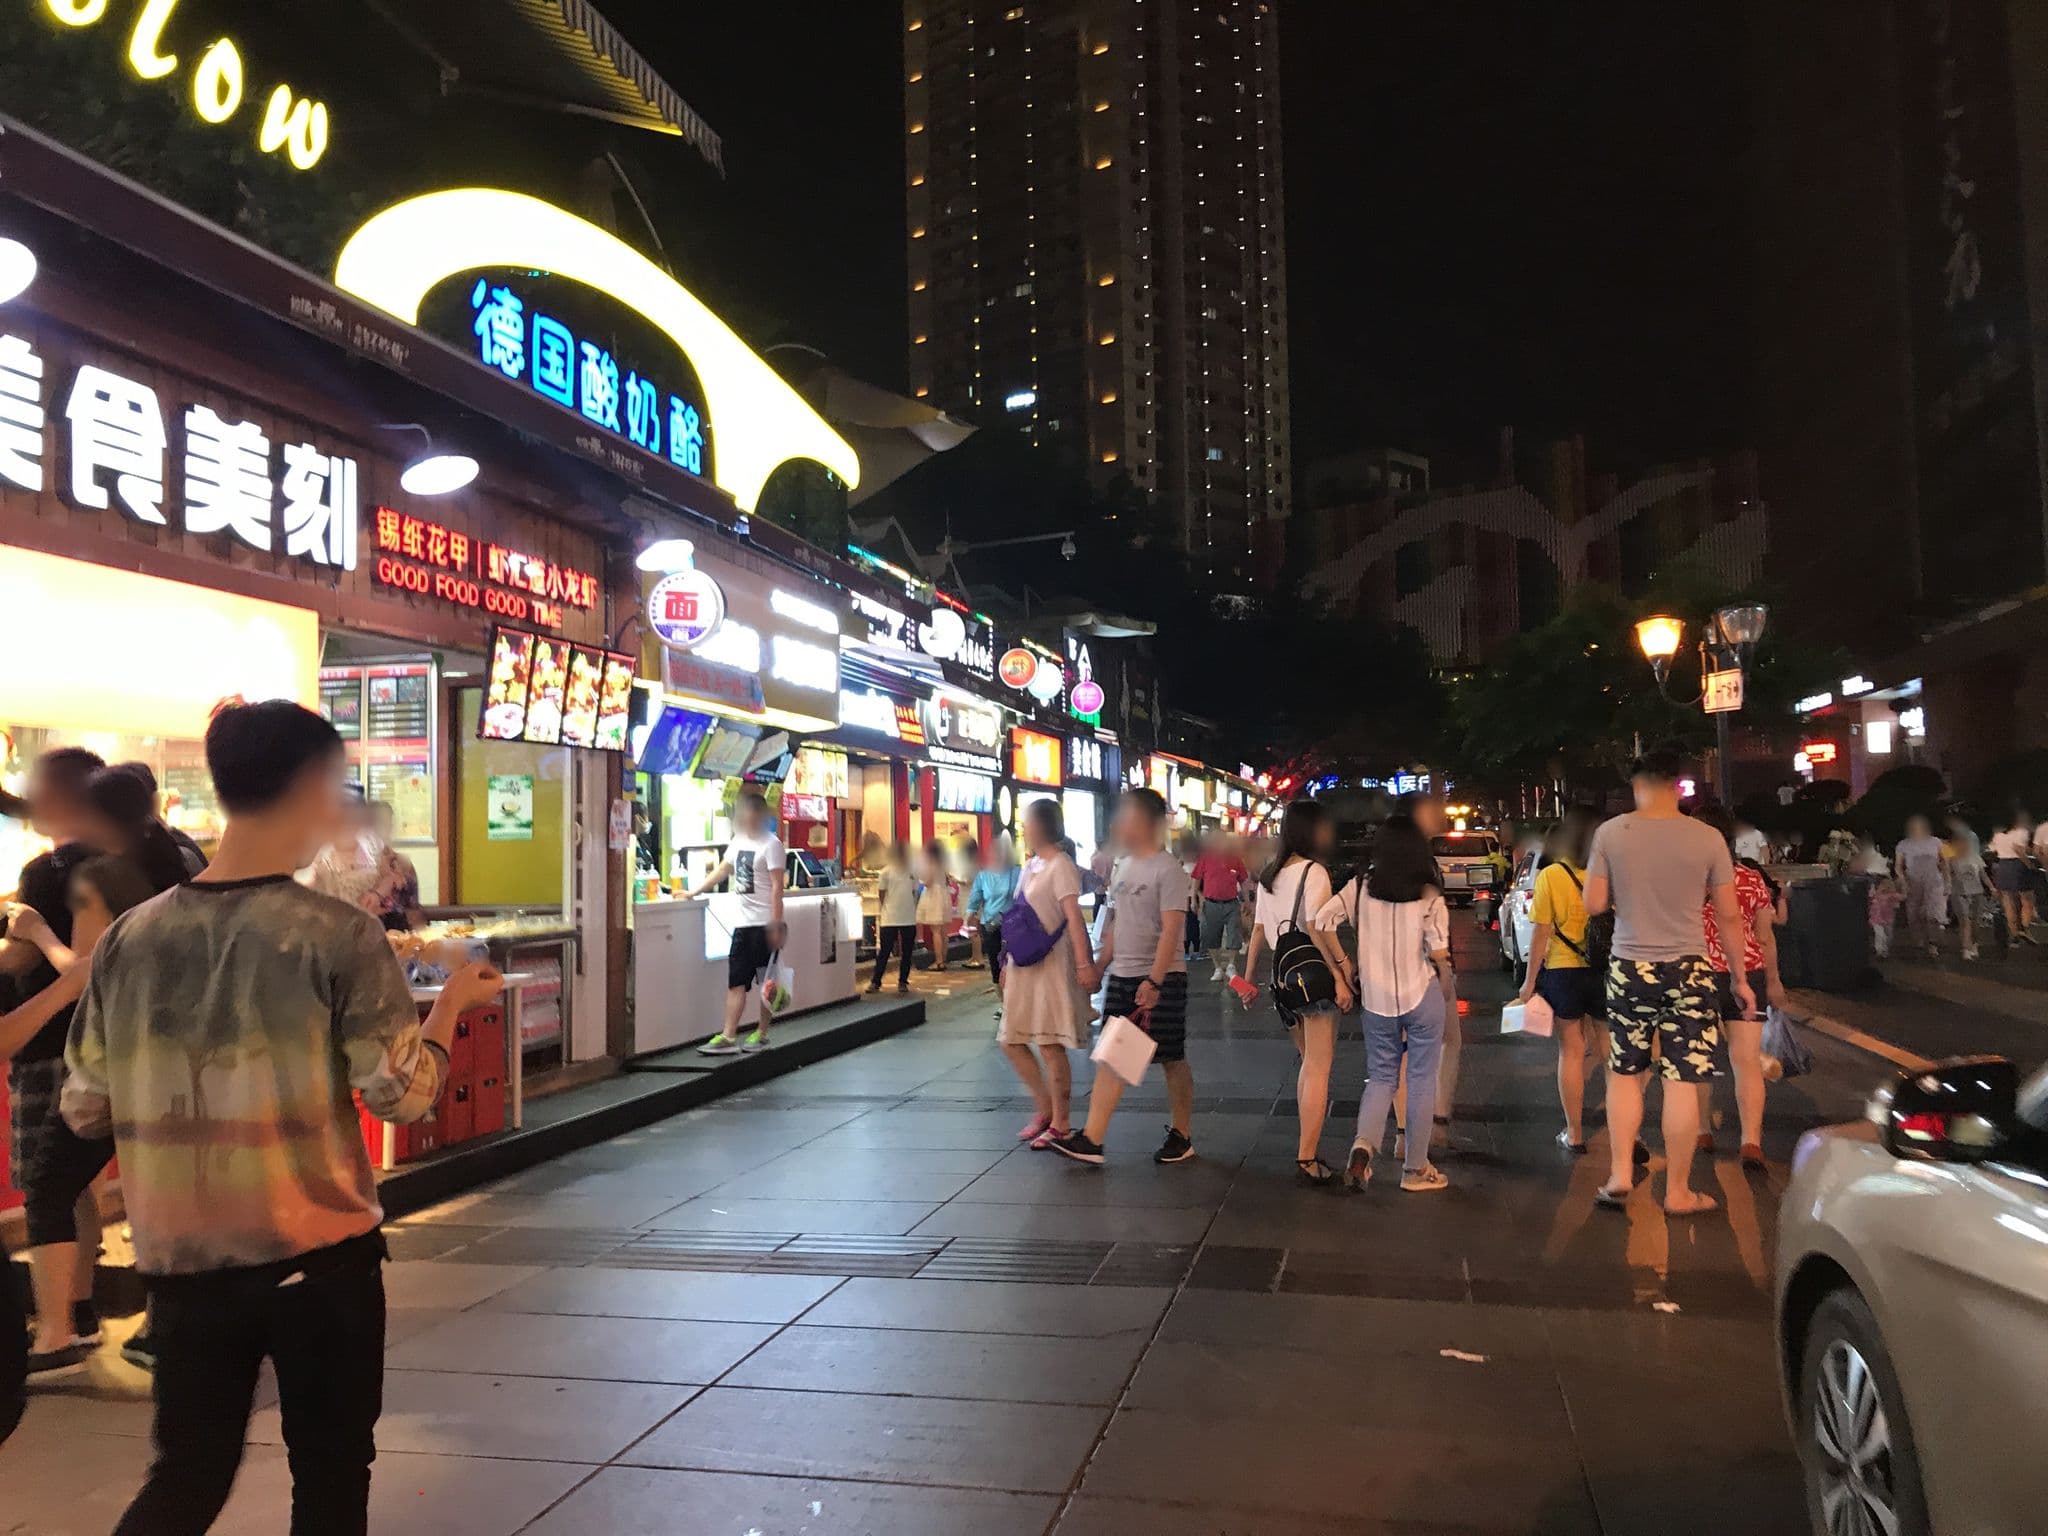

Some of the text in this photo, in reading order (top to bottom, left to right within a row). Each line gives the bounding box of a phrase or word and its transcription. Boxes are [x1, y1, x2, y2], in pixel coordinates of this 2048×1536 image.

[472, 278, 703, 475] 德国酸奶酪
[377, 506, 468, 572] 锡纸花甲
[378, 557, 562, 628] GOOD FOOD GOOD TIME
